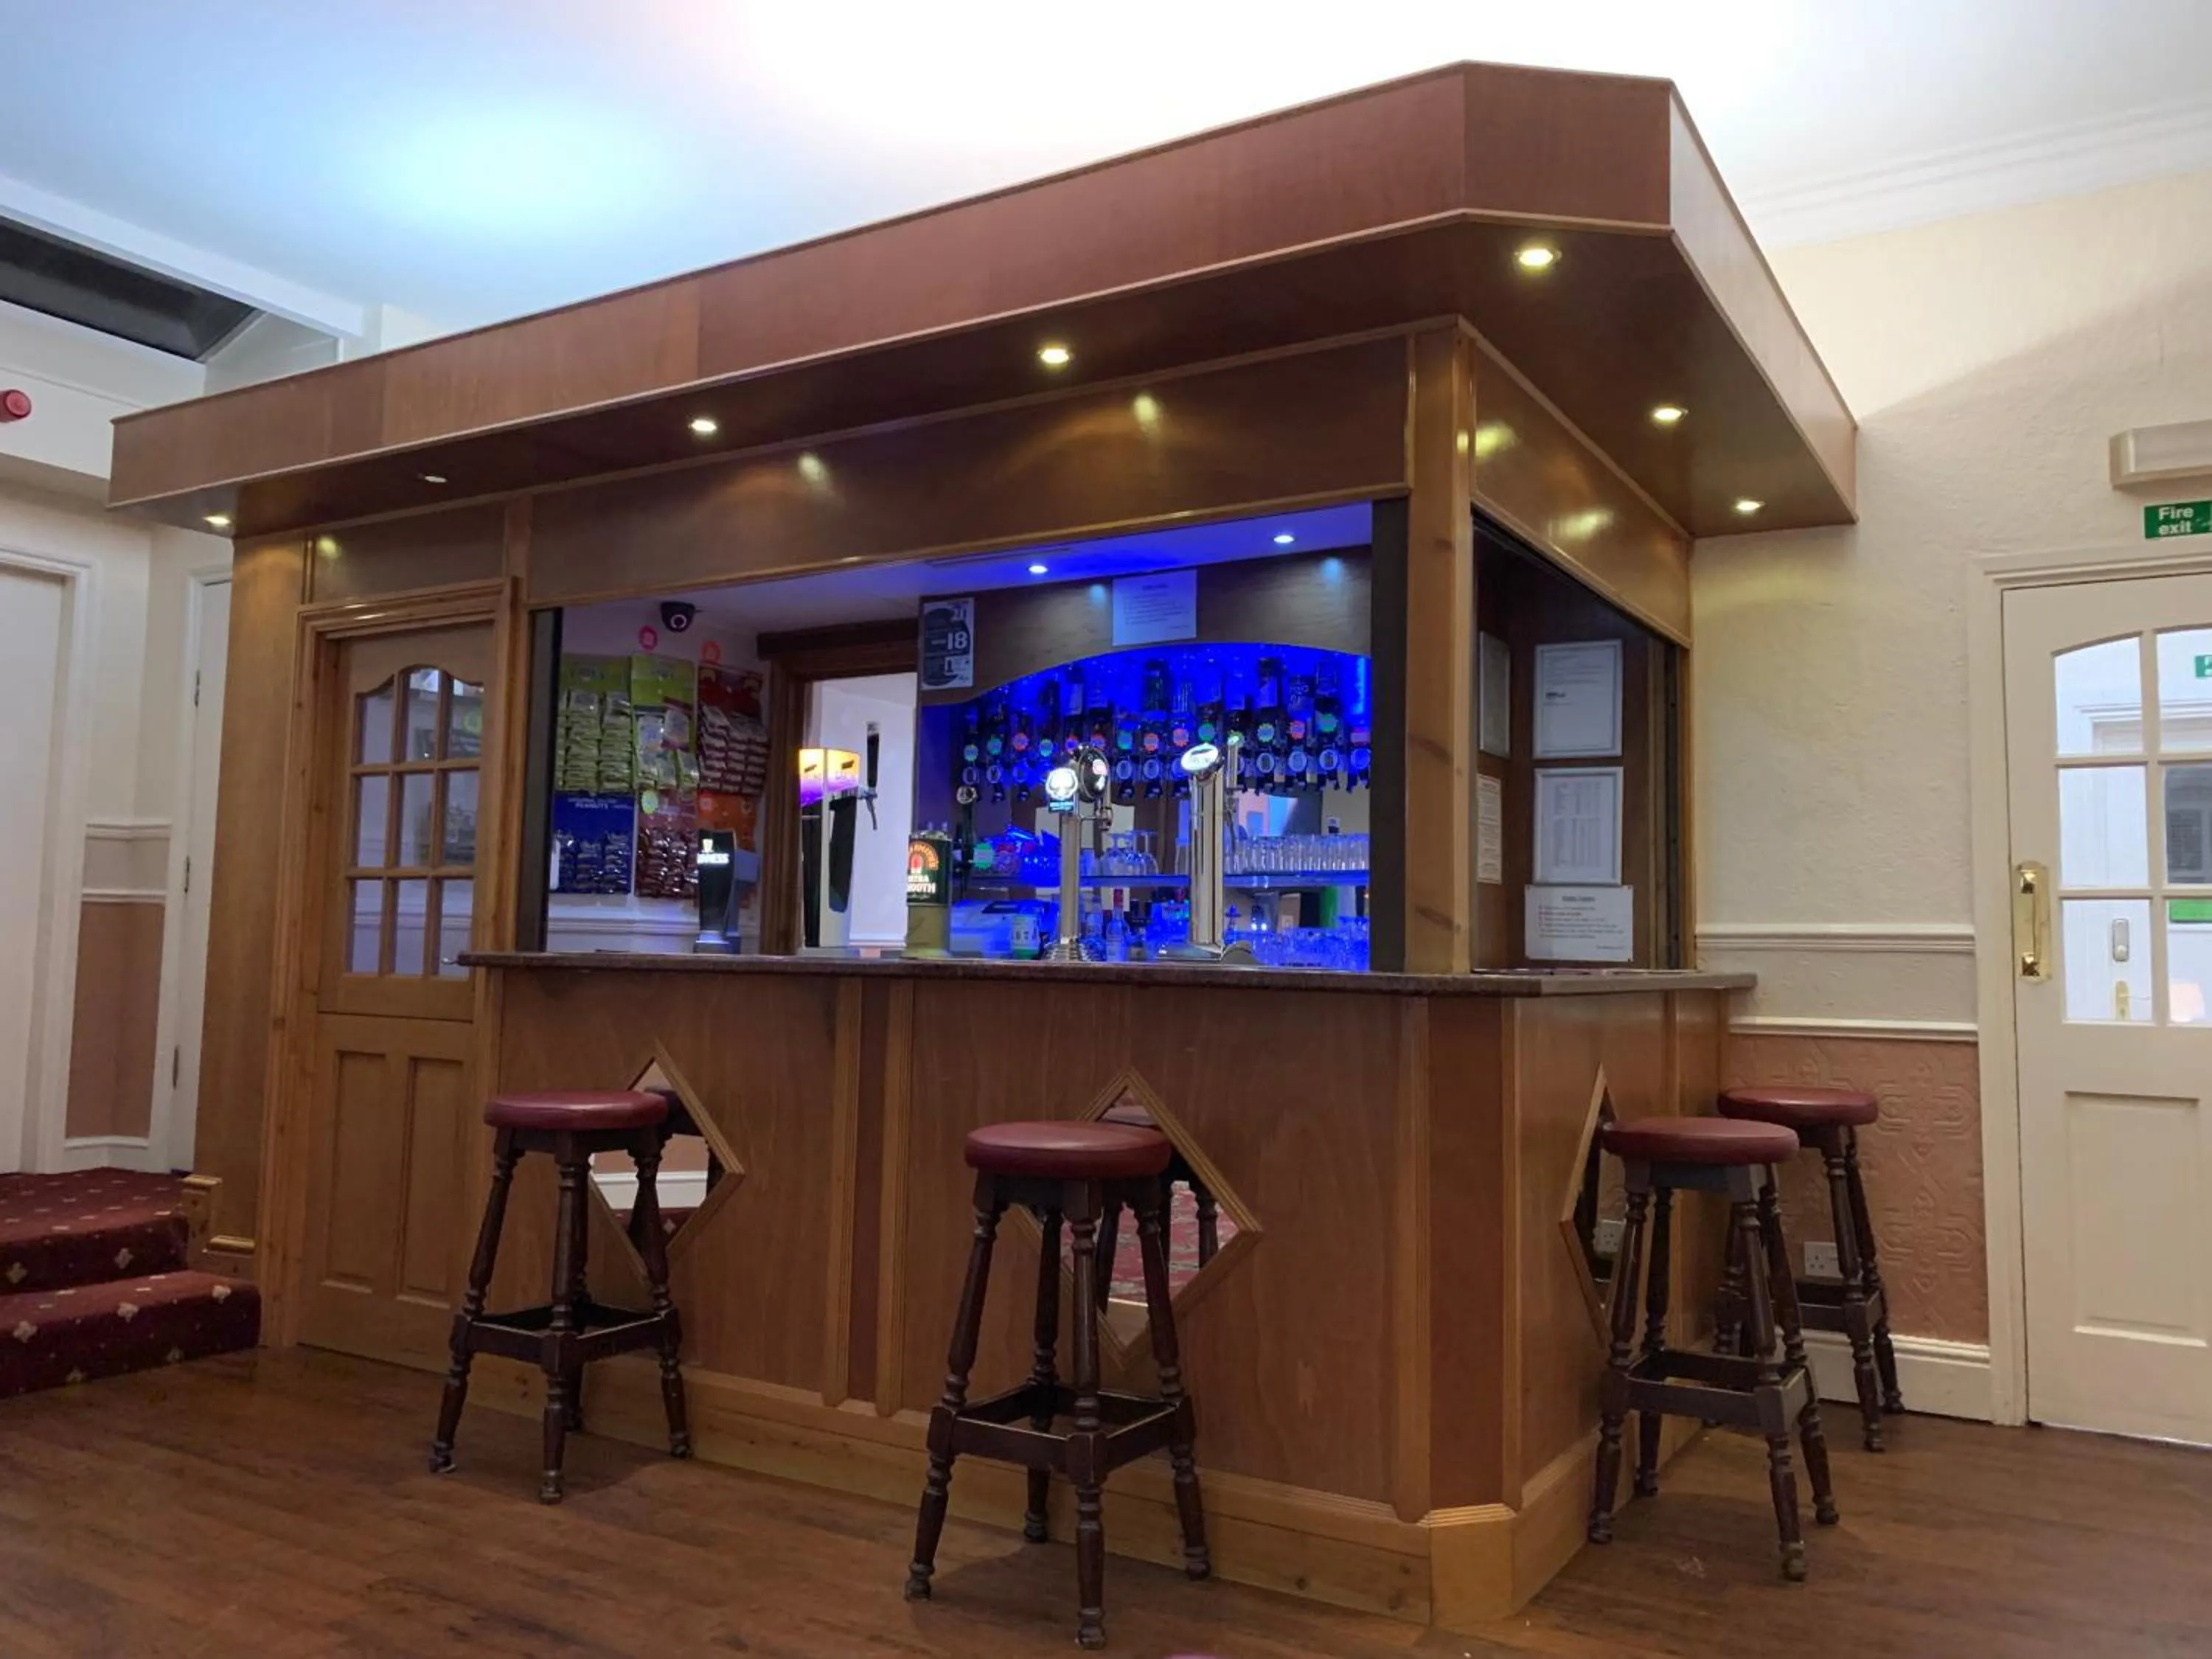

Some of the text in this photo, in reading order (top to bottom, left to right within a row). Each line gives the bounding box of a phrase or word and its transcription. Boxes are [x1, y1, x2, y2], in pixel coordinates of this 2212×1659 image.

[2158, 507, 2194, 520] Fire
[2158, 521, 2192, 535] exit
[947, 631, 967, 650] 18
